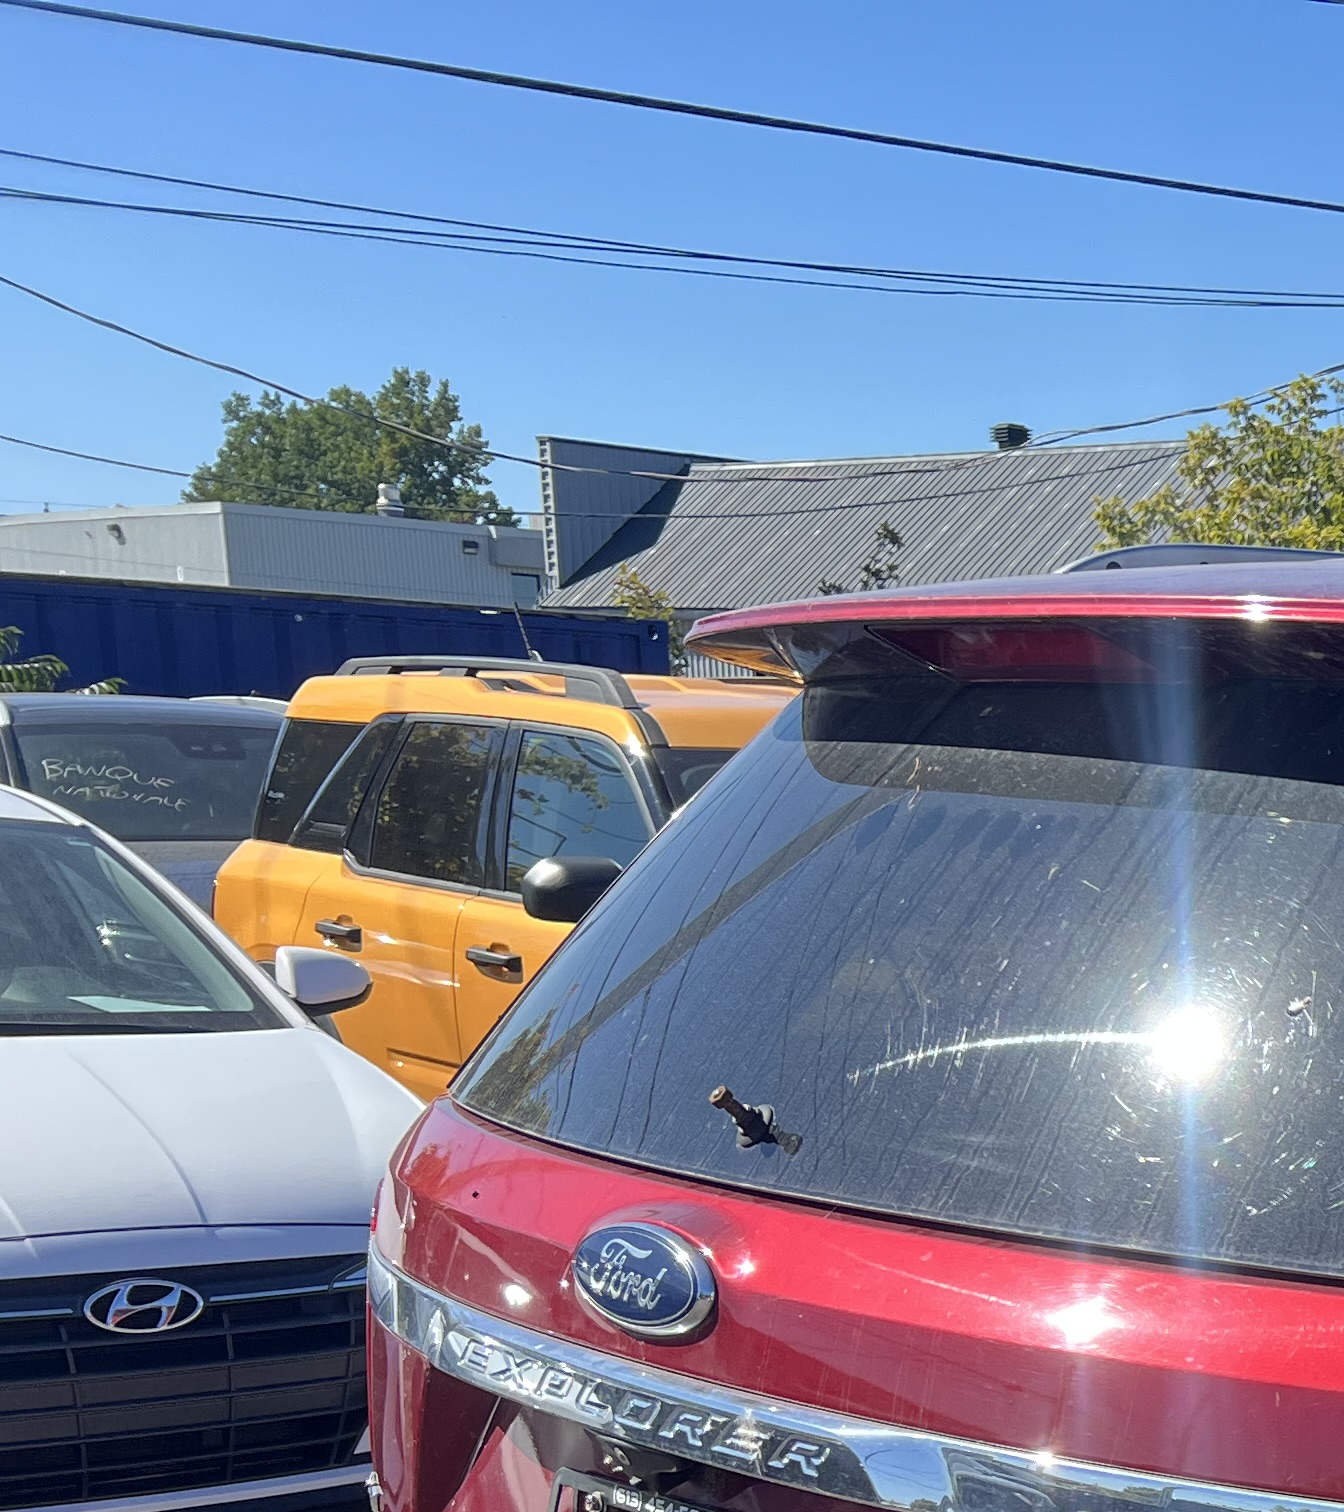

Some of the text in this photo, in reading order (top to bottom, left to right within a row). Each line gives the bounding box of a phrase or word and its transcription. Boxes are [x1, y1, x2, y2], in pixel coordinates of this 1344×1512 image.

[41, 758, 175, 789] BANQUE
[589, 1238, 668, 1310] Ford
[457, 1337, 831, 1478] EXPLORER
[612, 1485, 644, 1511] (613)
